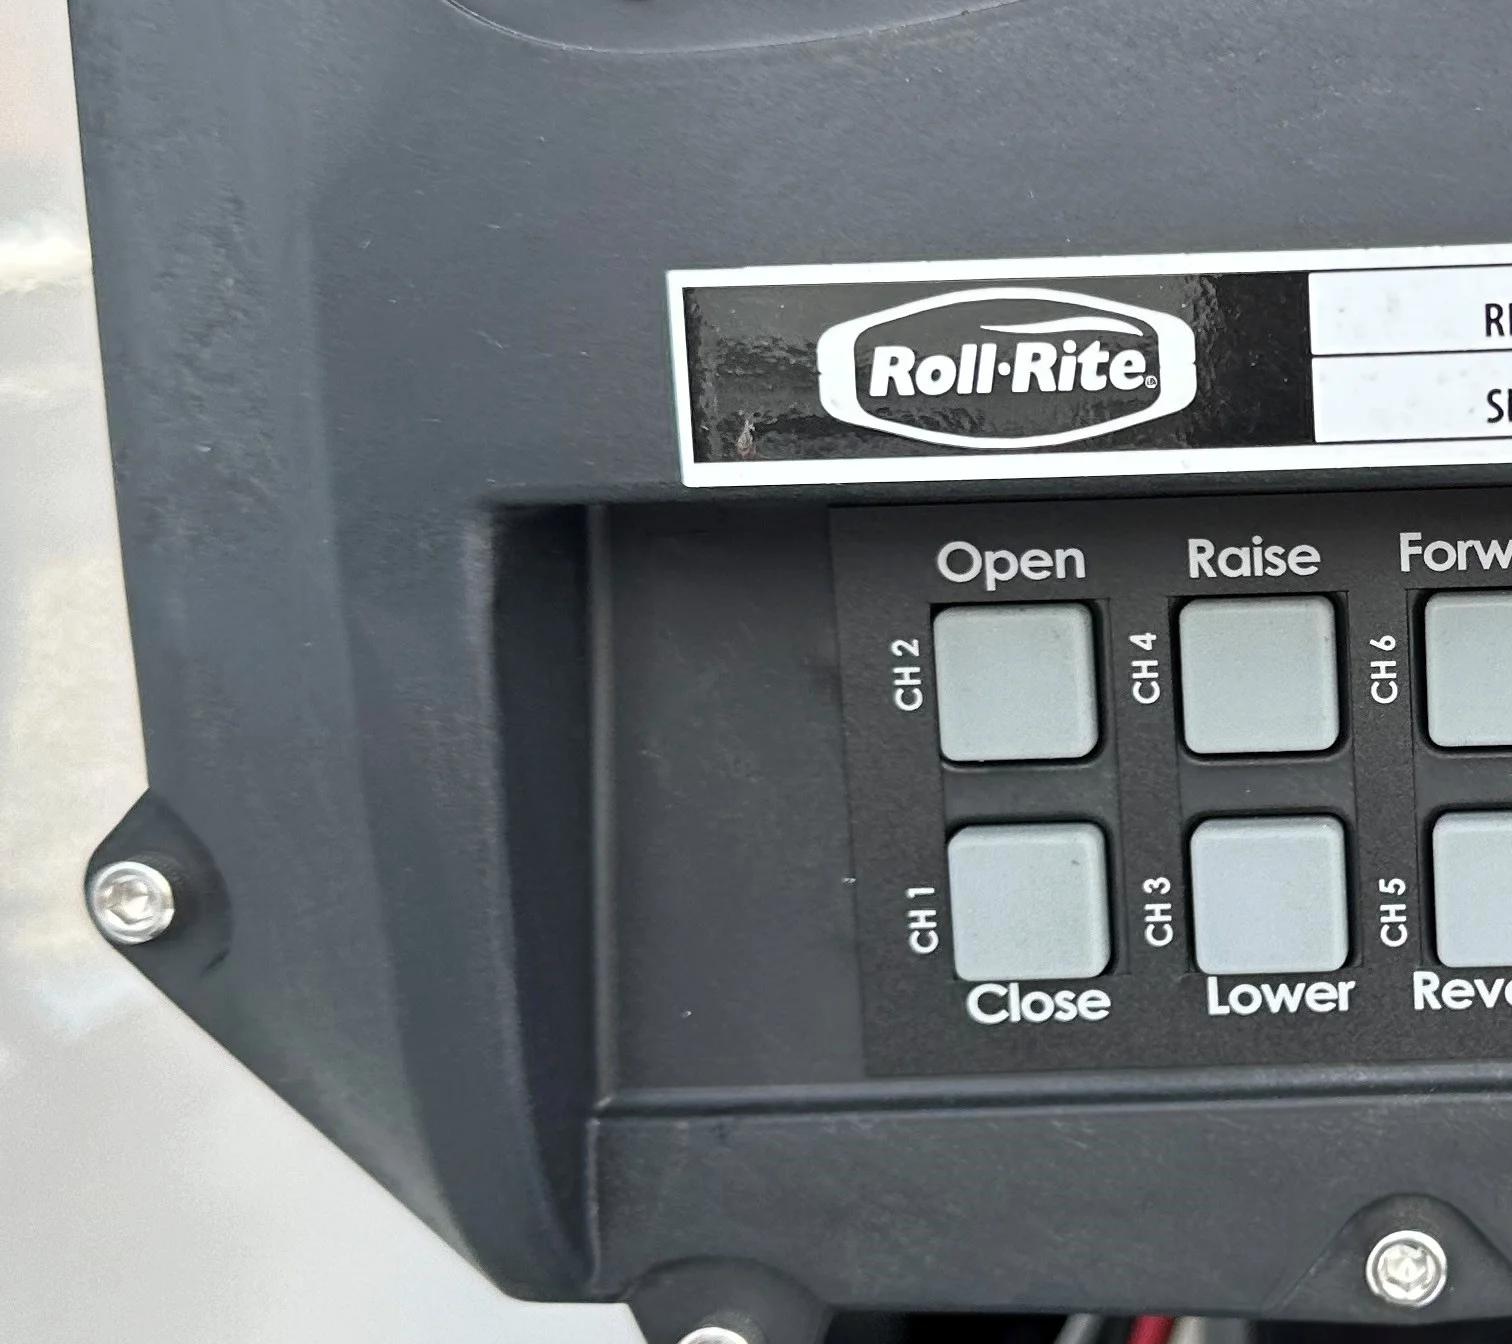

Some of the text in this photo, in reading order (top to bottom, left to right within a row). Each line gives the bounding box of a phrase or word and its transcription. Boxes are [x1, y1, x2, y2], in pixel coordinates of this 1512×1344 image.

[937, 540, 1086, 591] Open
[1187, 535, 1321, 579] Raise
[890, 638, 923, 712] CH 2
[1129, 632, 1161, 704] CH 4
[1369, 634, 1398, 704] CH 6
[906, 886, 938, 954] CH 1
[1142, 876, 1174, 947] CH 3
[1378, 877, 1409, 947] CH 5
[966, 982, 1111, 1024] Close
[1206, 978, 1356, 1016] Lower
